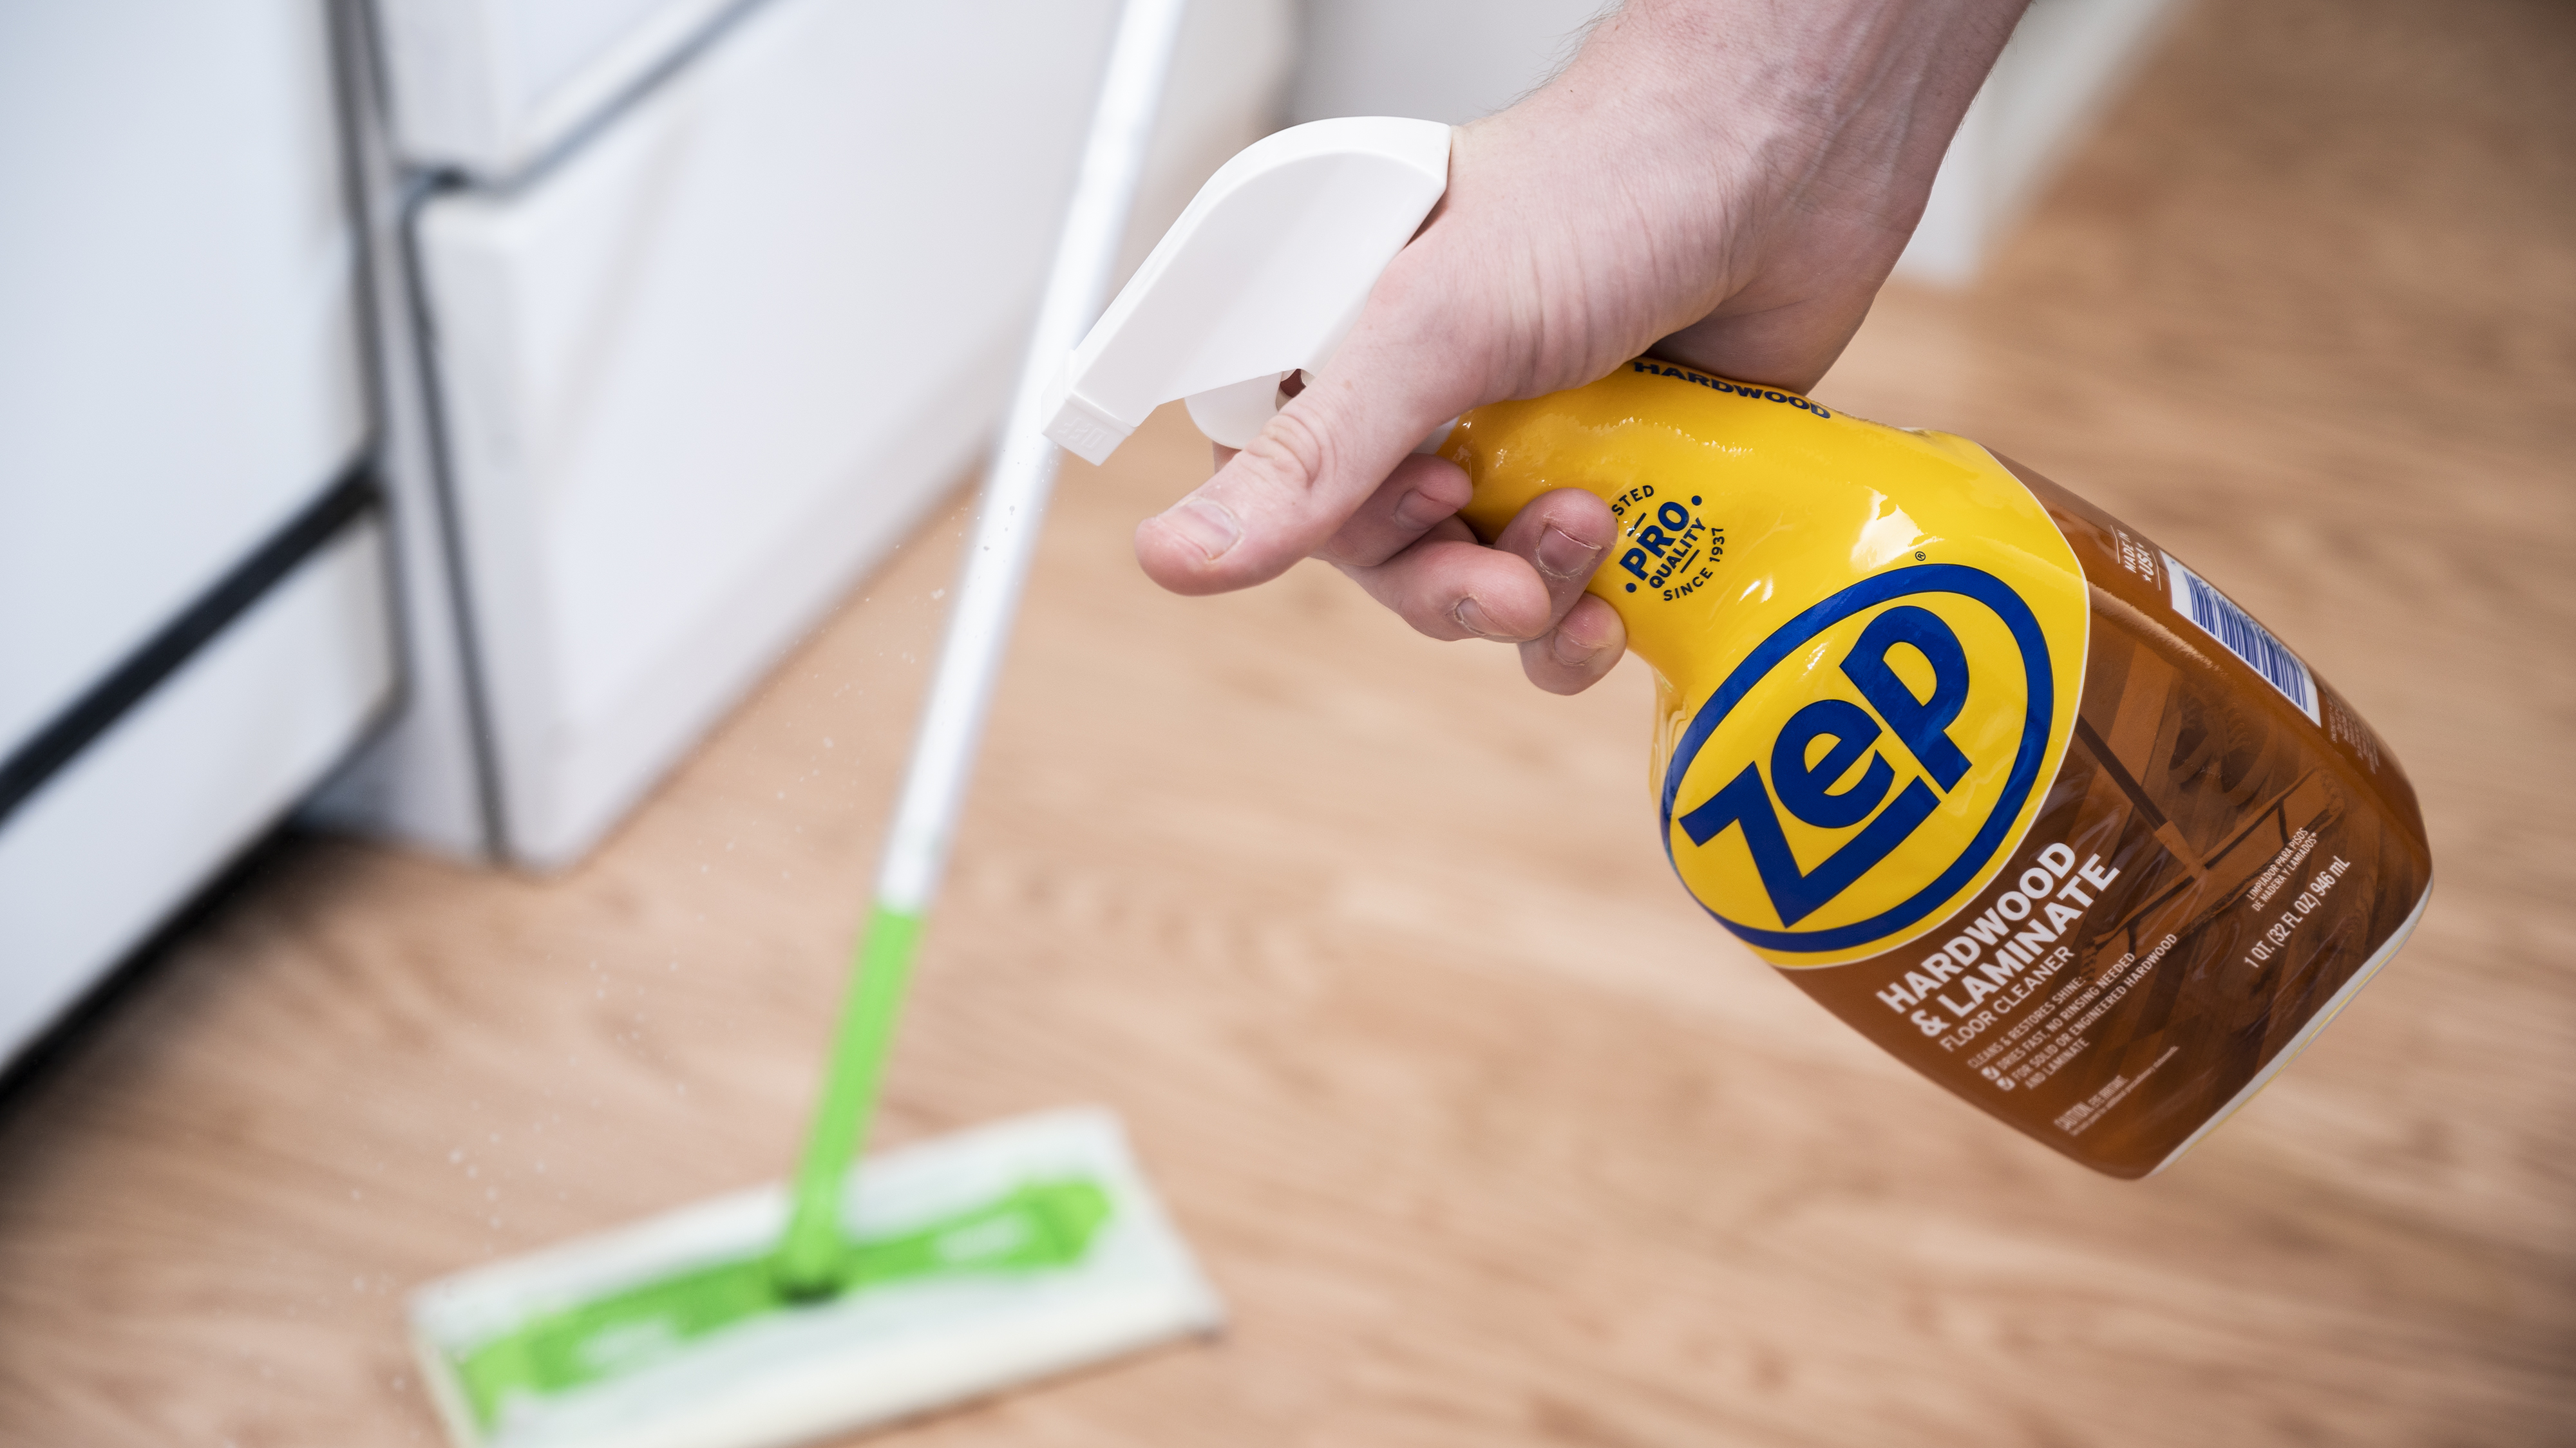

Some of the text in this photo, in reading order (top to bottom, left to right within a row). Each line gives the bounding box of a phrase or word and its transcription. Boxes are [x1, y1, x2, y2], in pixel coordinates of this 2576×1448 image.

[1634, 362, 1831, 418] HARDWOOD
[1611, 485, 1654, 517] STED
[1619, 501, 1690, 581] PRO
[1649, 517, 1706, 588] QUALITY
[1663, 527, 1725, 601] SINCE 1937
[2117, 529, 2137, 574] MADE IN
[2135, 547, 2154, 576] USA
[2246, 827, 2308, 900] LIMPIADOR PARA PISOS
[2251, 899, 2264, 912] DE
[2260, 874, 2287, 902] MADERA
[2282, 867, 2291, 876] Y
[1877, 842, 2076, 1014] HARDWOOD
[1911, 853, 2120, 1037] & LAMINATE
[2244, 855, 2351, 968] 1 QT. (32 FL OZ) 946 mL
[1939, 946, 2074, 1052] FLOOR CLEANER
[1967, 976, 2086, 1069] CLEANS & RESTORES SHINE:
[1997, 952, 2136, 1071] DRIES FAST, NO RINSING NEEDED
[2011, 934, 2177, 1081] FOR SOLID OR ENGINEERED HARDWOOD
[2025, 1037, 2090, 1089] AND LAMINATE
